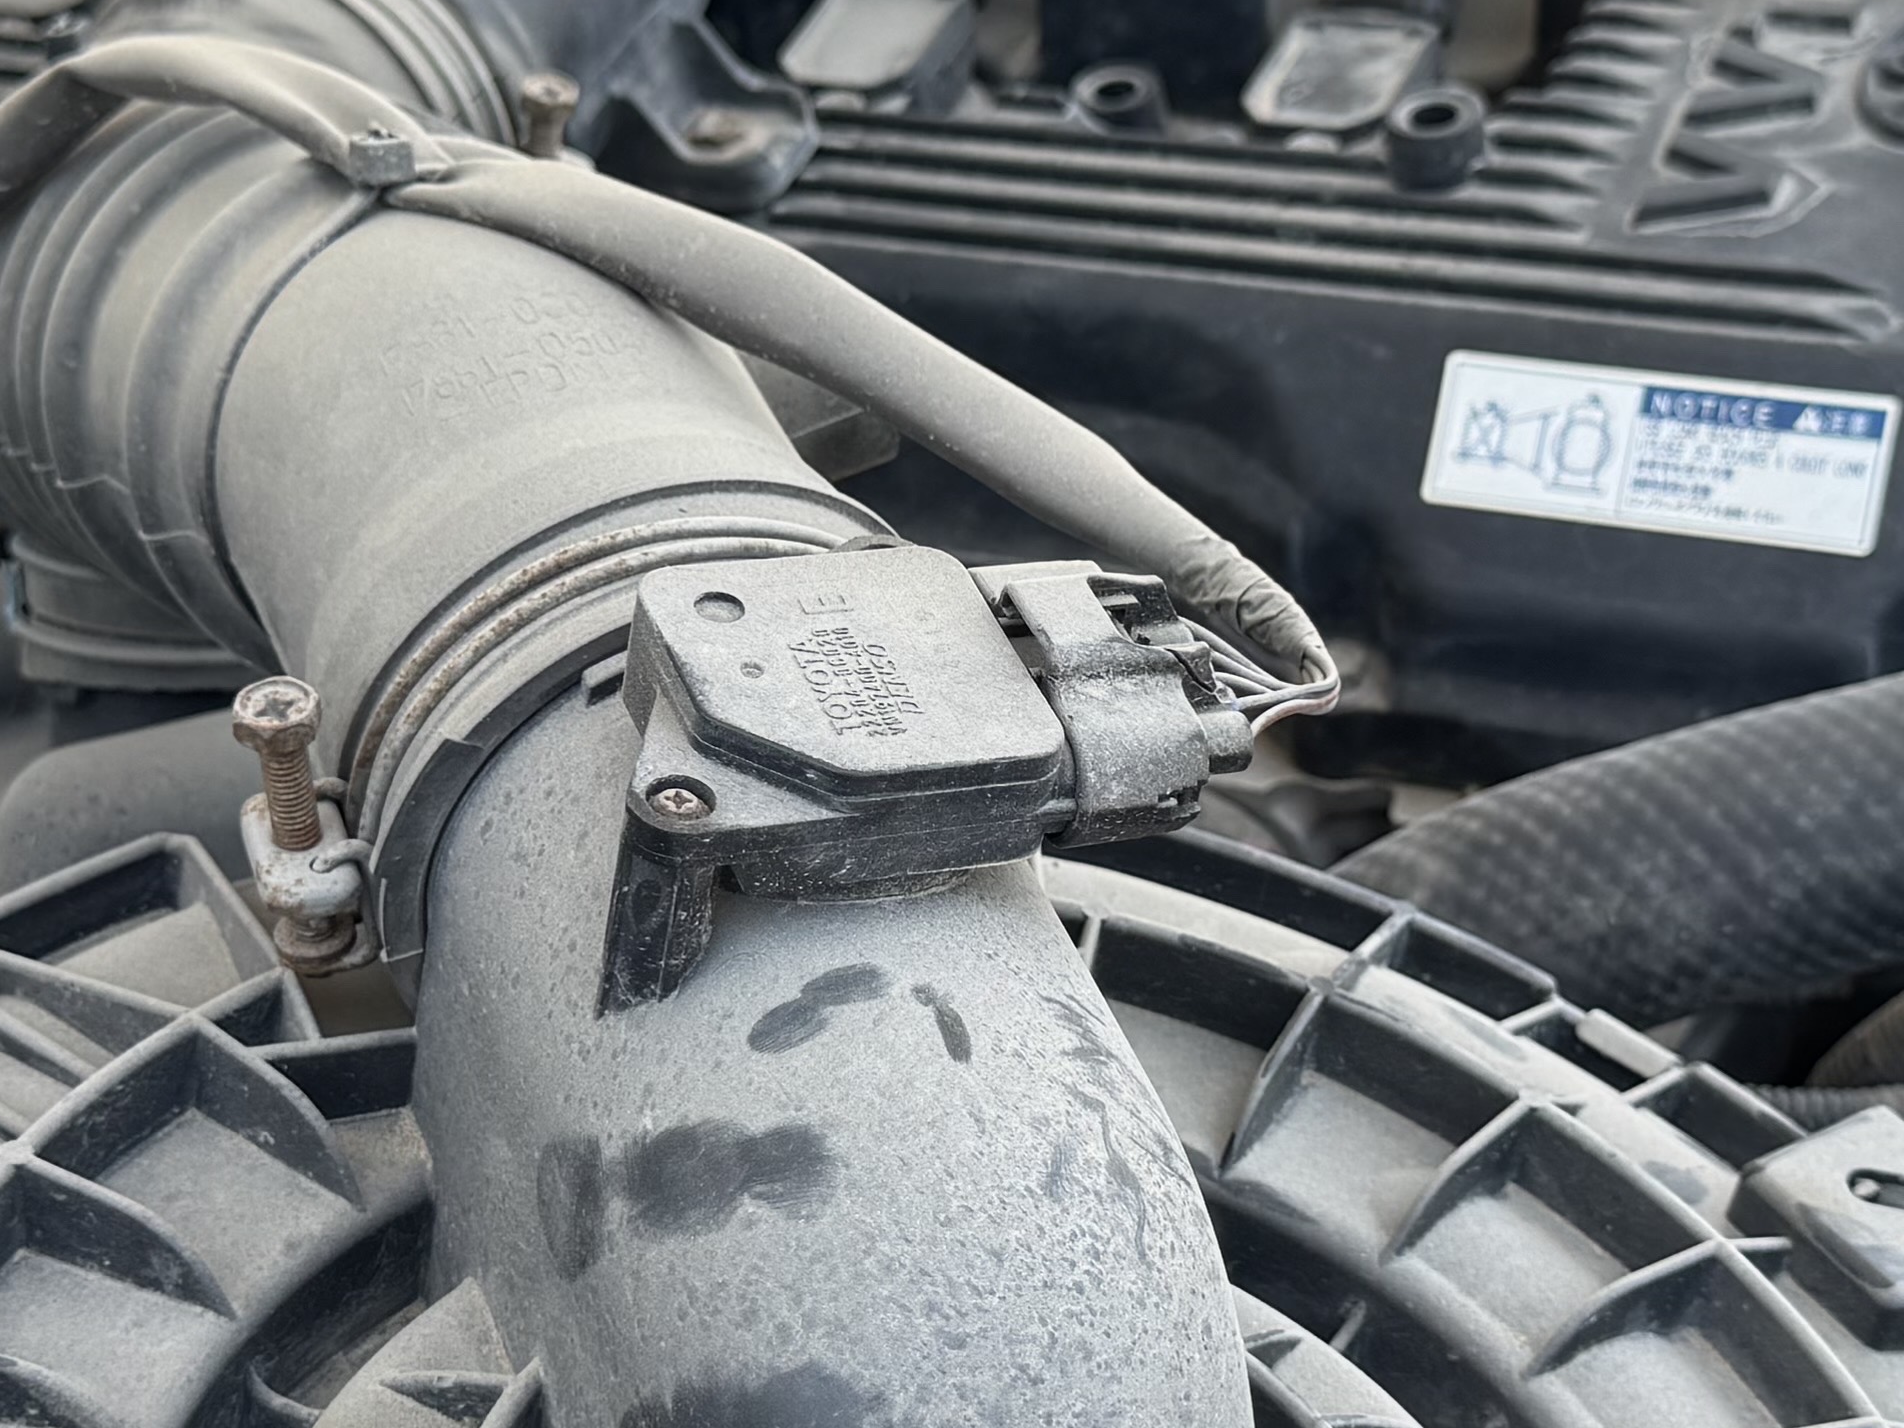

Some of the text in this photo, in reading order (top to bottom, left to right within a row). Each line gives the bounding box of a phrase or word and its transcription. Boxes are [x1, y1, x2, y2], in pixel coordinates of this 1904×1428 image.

[1650, 389, 1778, 430] NOTICE
[787, 639, 862, 736] TOYOTA
[862, 642, 925, 715] DENSO
